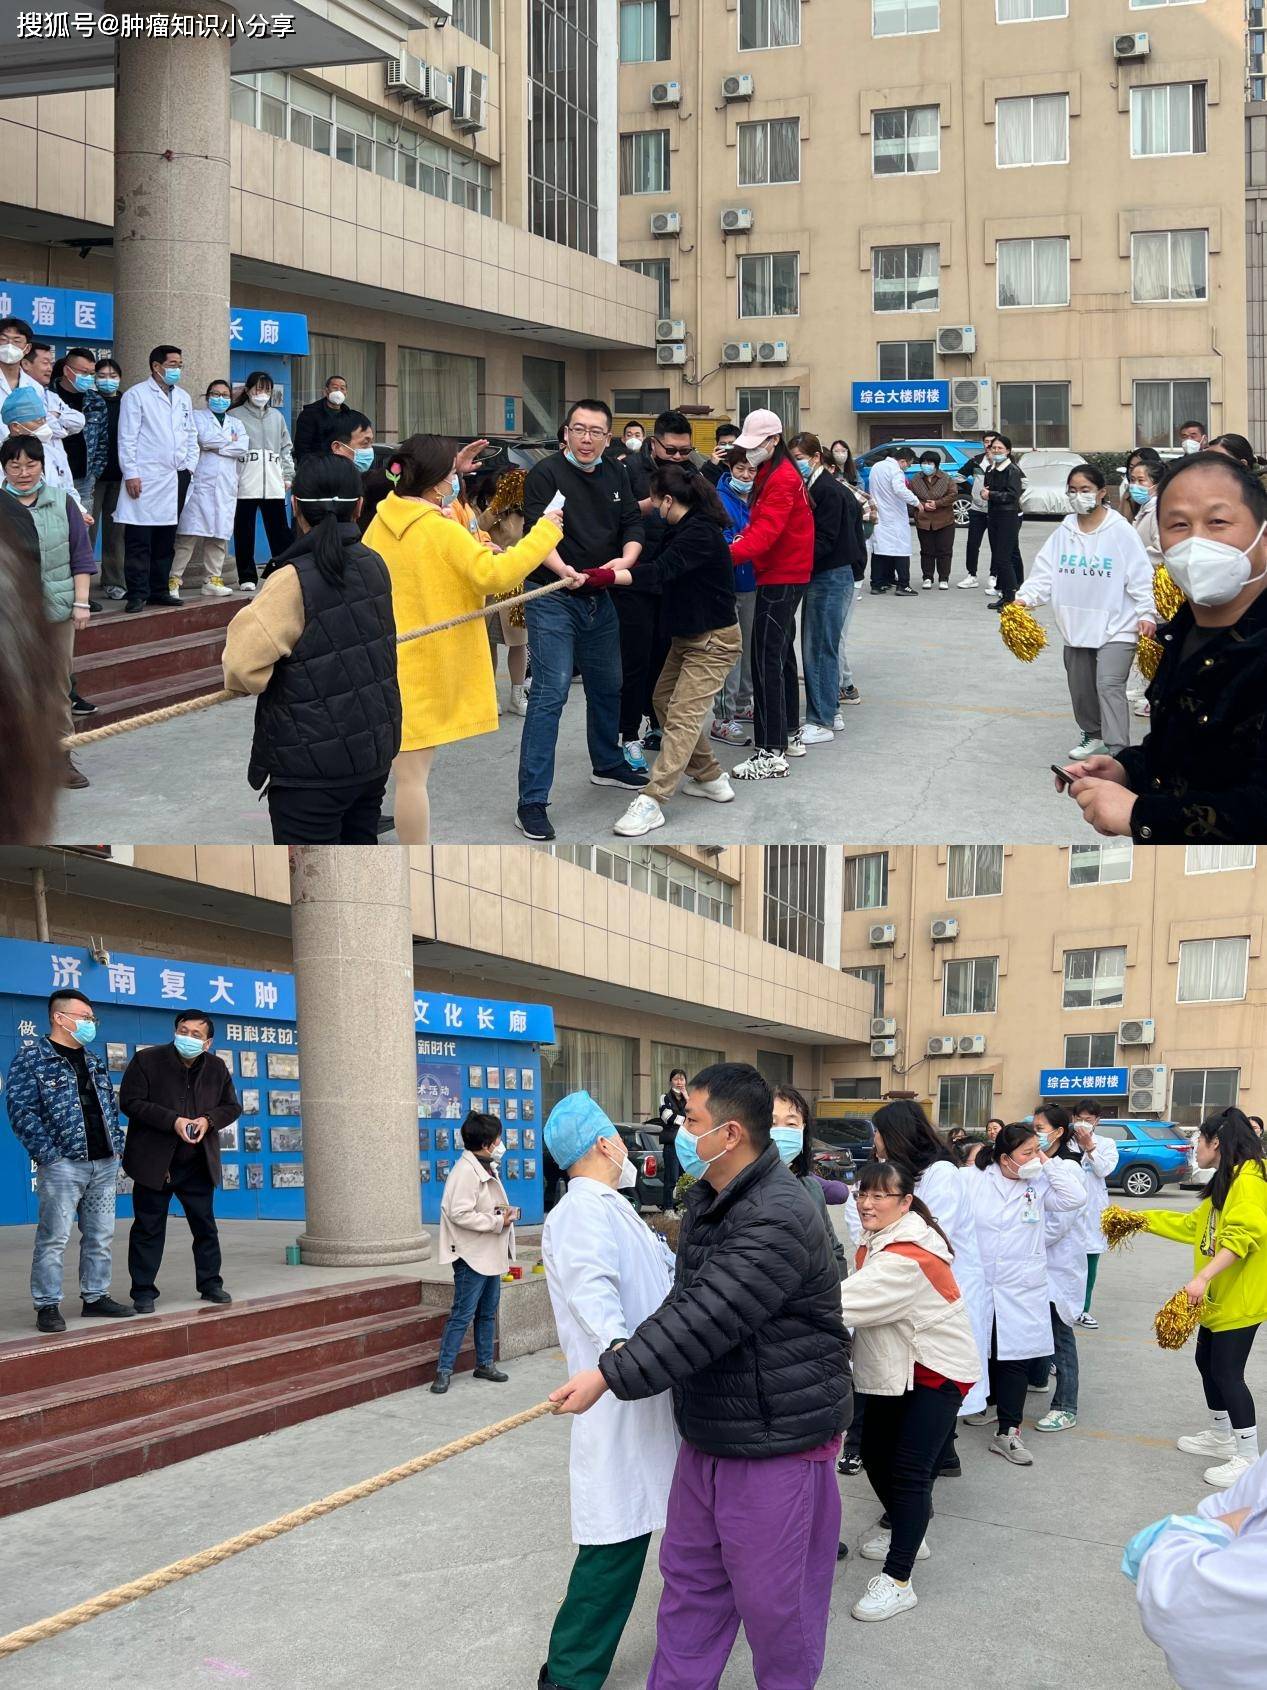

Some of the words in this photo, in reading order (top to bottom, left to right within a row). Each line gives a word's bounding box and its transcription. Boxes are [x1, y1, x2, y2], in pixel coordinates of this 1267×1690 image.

[860, 389, 940, 404] 综合大楼附楼
[1060, 554, 1112, 570] PEACE
[1083, 568, 1112, 577] LOVE
[51, 954, 278, 1010] 济南复大肿
[414, 999, 527, 1034] 文化长廊
[226, 1023, 298, 1045] 用科技的
[417, 1039, 456, 1057] 新时代
[1047, 1075, 1119, 1089] 综合大楼附楼
